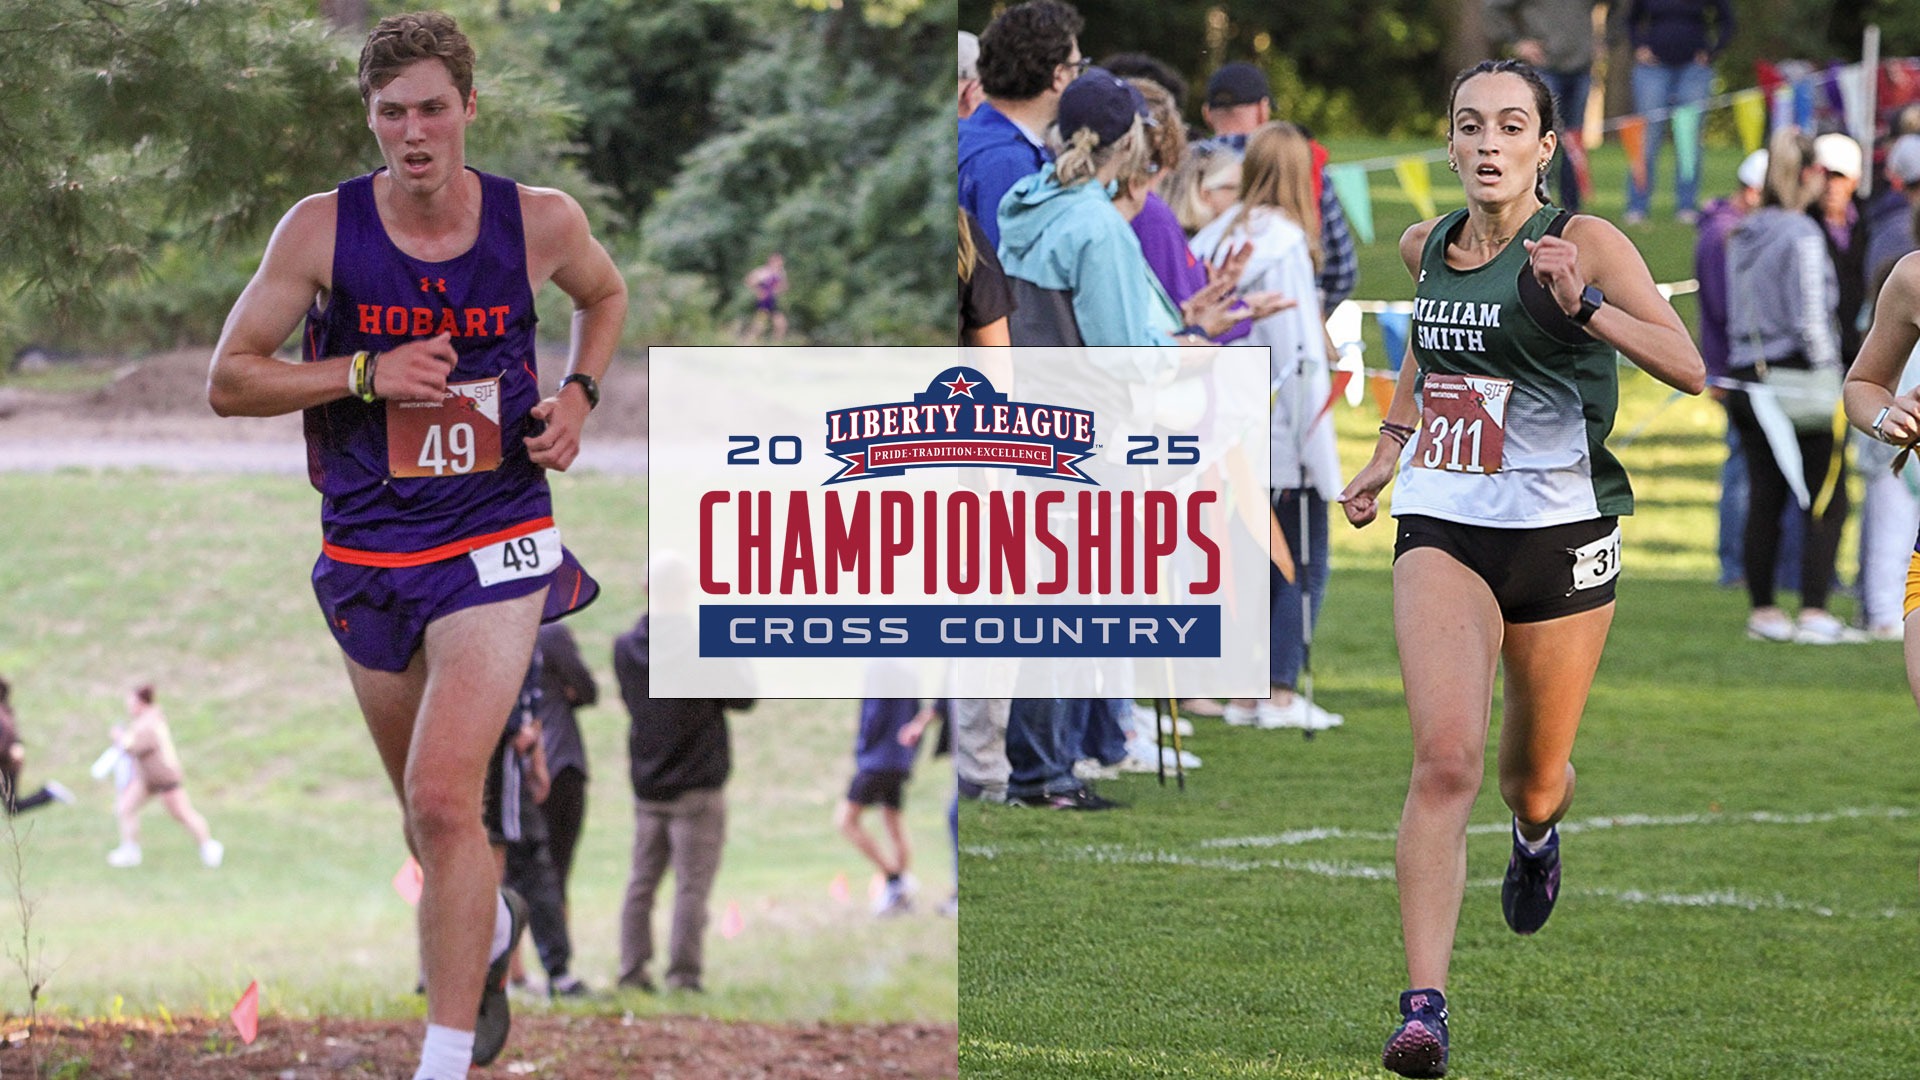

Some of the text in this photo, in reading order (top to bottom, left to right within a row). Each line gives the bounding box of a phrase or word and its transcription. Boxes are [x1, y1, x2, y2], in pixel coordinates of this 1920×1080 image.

[357, 304, 510, 337] HOBART
[1418, 325, 1486, 352] SMITH
[417, 422, 476, 475] 49
[1423, 416, 1484, 472] 311
[503, 537, 540, 571] 49
